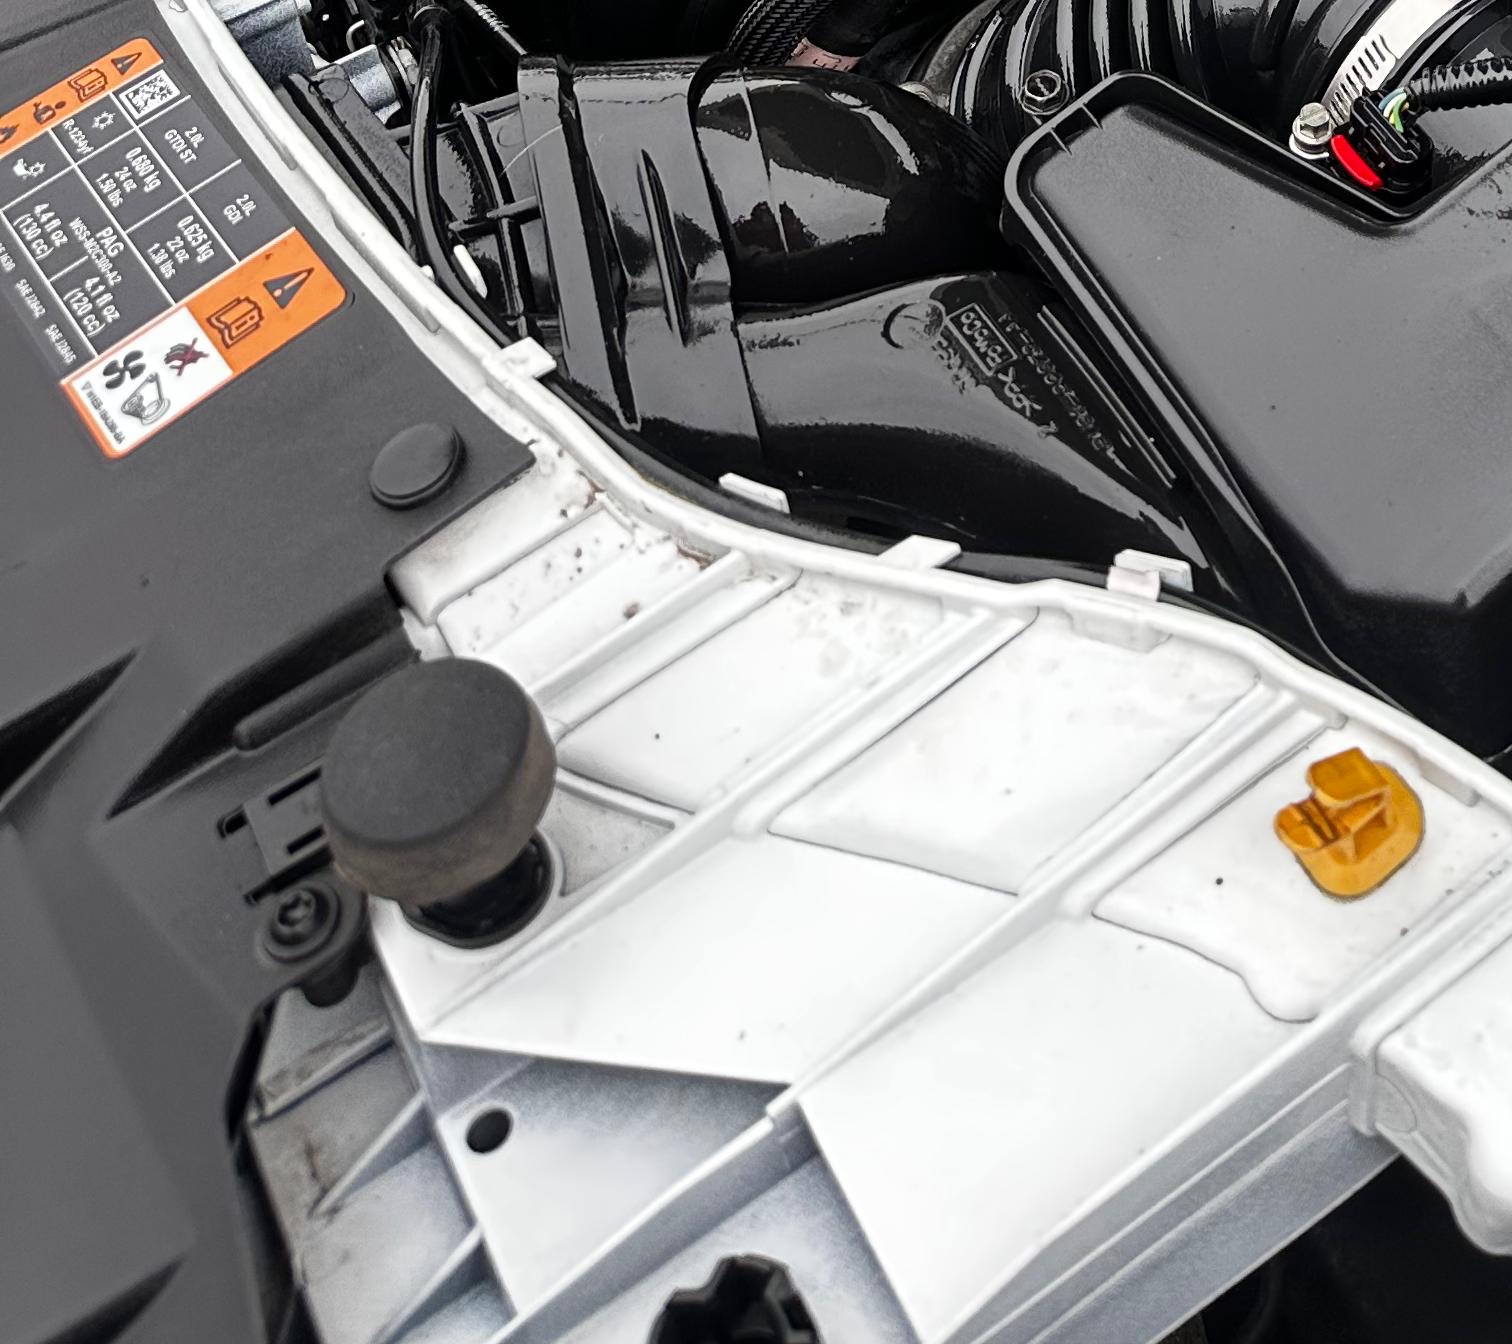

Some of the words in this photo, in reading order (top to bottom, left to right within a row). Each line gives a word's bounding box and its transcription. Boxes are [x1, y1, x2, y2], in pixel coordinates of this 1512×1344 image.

[62, 119, 94, 154] R-1234yf
[164, 129, 187, 153] GTDI
[179, 149, 197, 164] ST
[184, 126, 204, 148] 2.0L
[114, 166, 132, 181] 24
[123, 179, 137, 193] oz
[125, 147, 154, 177] 0.680
[144, 171, 161, 193] kg
[96, 173, 116, 194] 1.50
[107, 188, 123, 207] lbs
[34, 203, 55, 223] 4.4
[224, 205, 243, 224] GDI
[236, 194, 256, 216] 2.0L
[13, 213, 41, 241] (130
[31, 239, 54, 260] cc)
[44, 218, 61, 232] fl
[50, 230, 68, 247] oz
[96, 226, 124, 257] PAG
[166, 236, 184, 252] 22
[175, 249, 189, 263] oz
[177, 215, 208, 247] 0.625
[196, 240, 214, 263] kg
[159, 259, 175, 279] lbs
[85, 277, 106, 297] 4.1
[63, 288, 93, 316] (120
[82, 314, 106, 336] cc)
[96, 293, 113, 307] fl
[102, 305, 120, 323] oz
